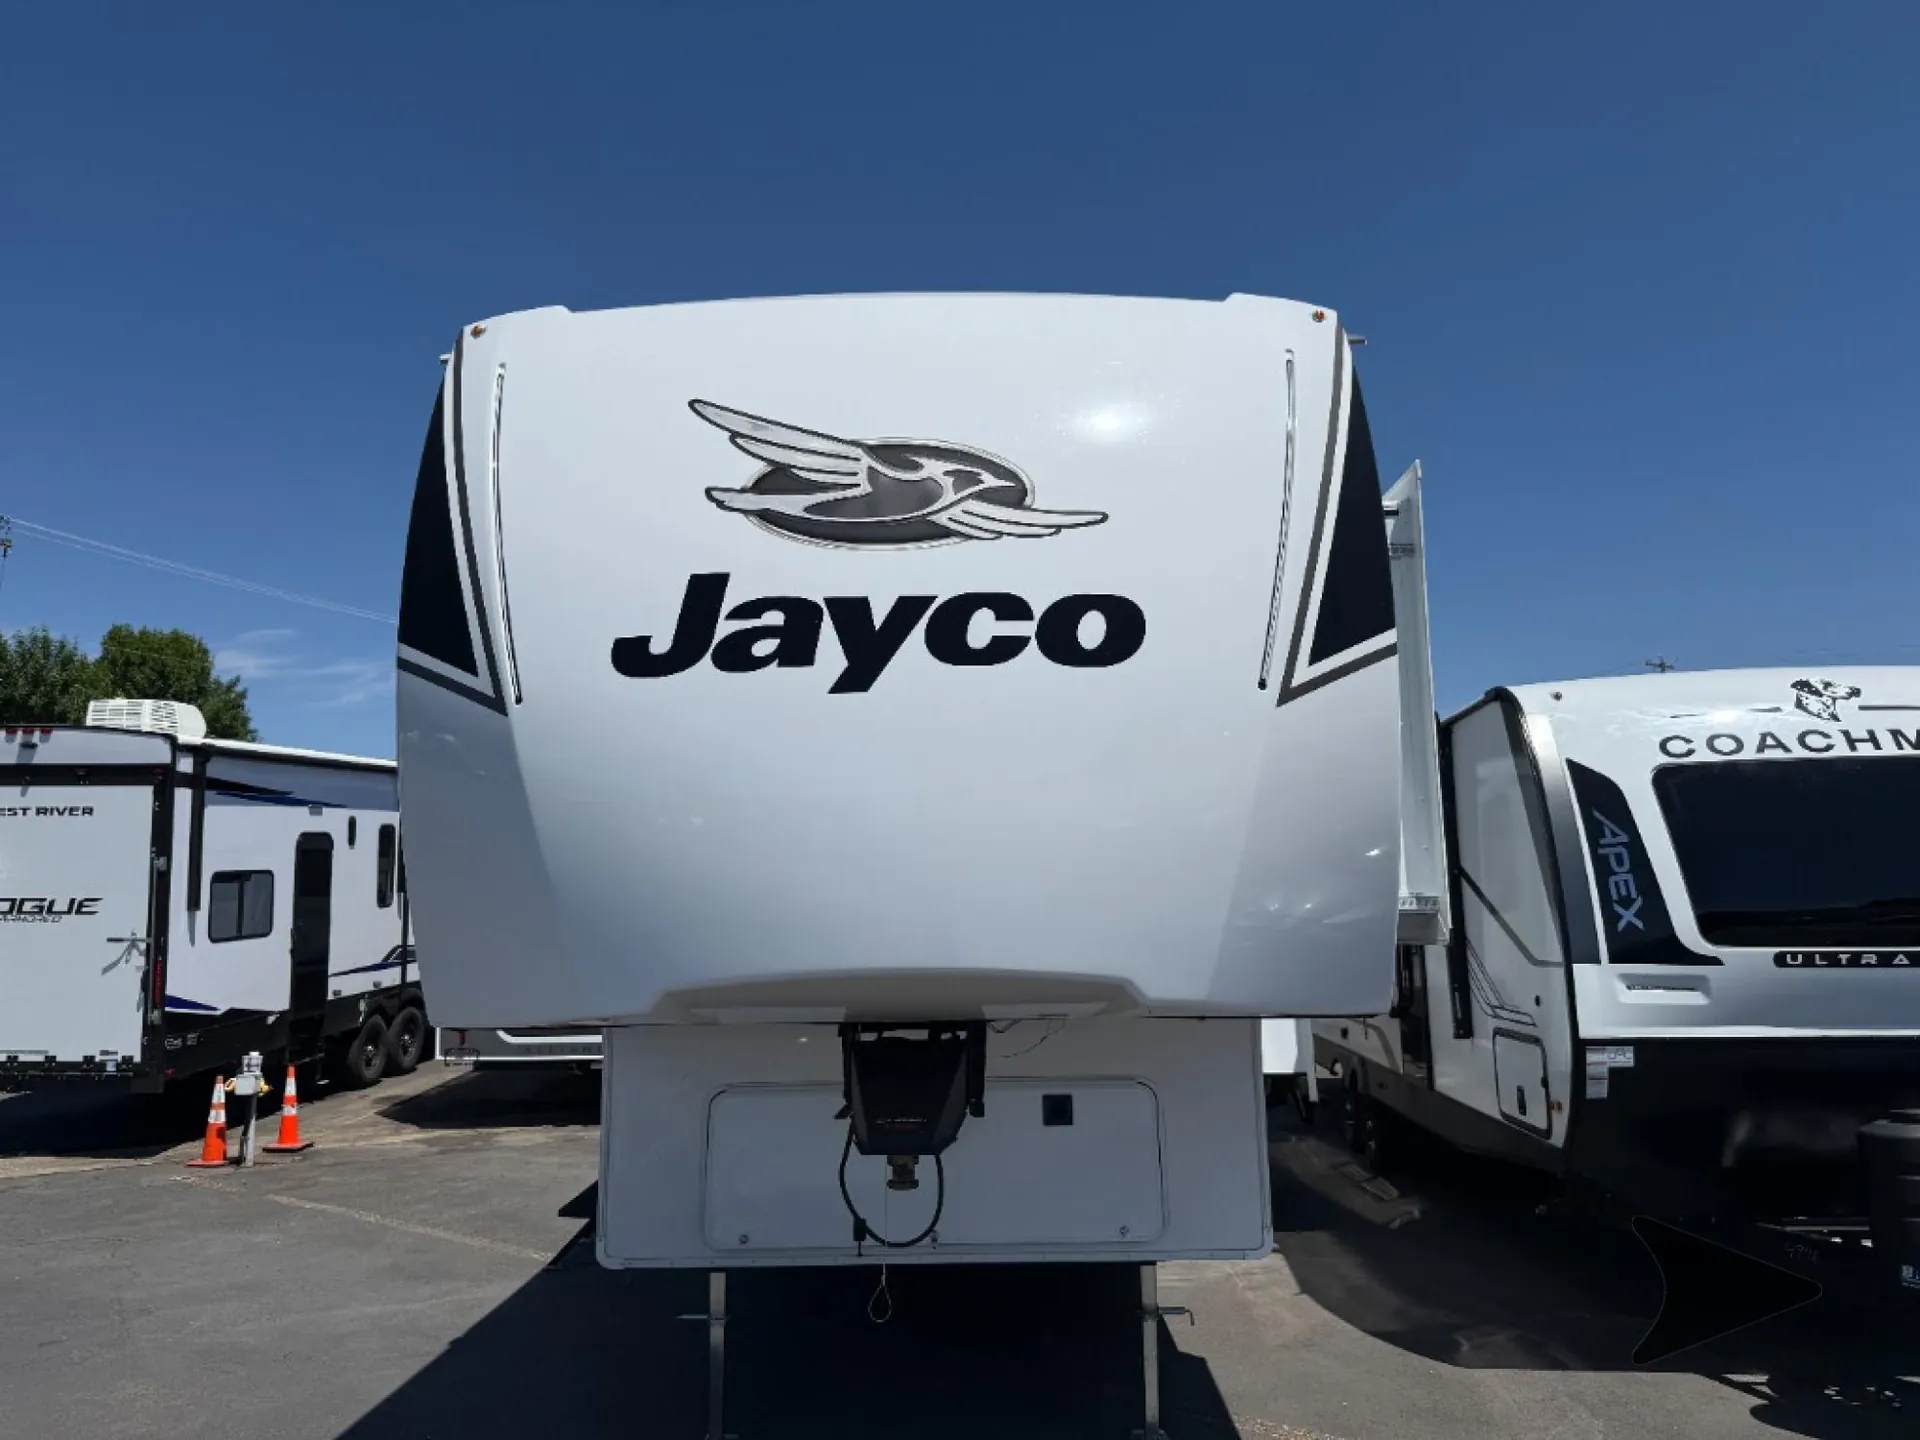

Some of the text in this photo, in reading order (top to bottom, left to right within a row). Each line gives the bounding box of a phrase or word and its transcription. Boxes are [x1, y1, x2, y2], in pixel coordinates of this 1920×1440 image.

[611, 572, 1147, 694] Jayco
[35, 806, 94, 816] RIVER
[1592, 807, 1645, 932] APEX
[1786, 953, 1910, 965] ULTRA
